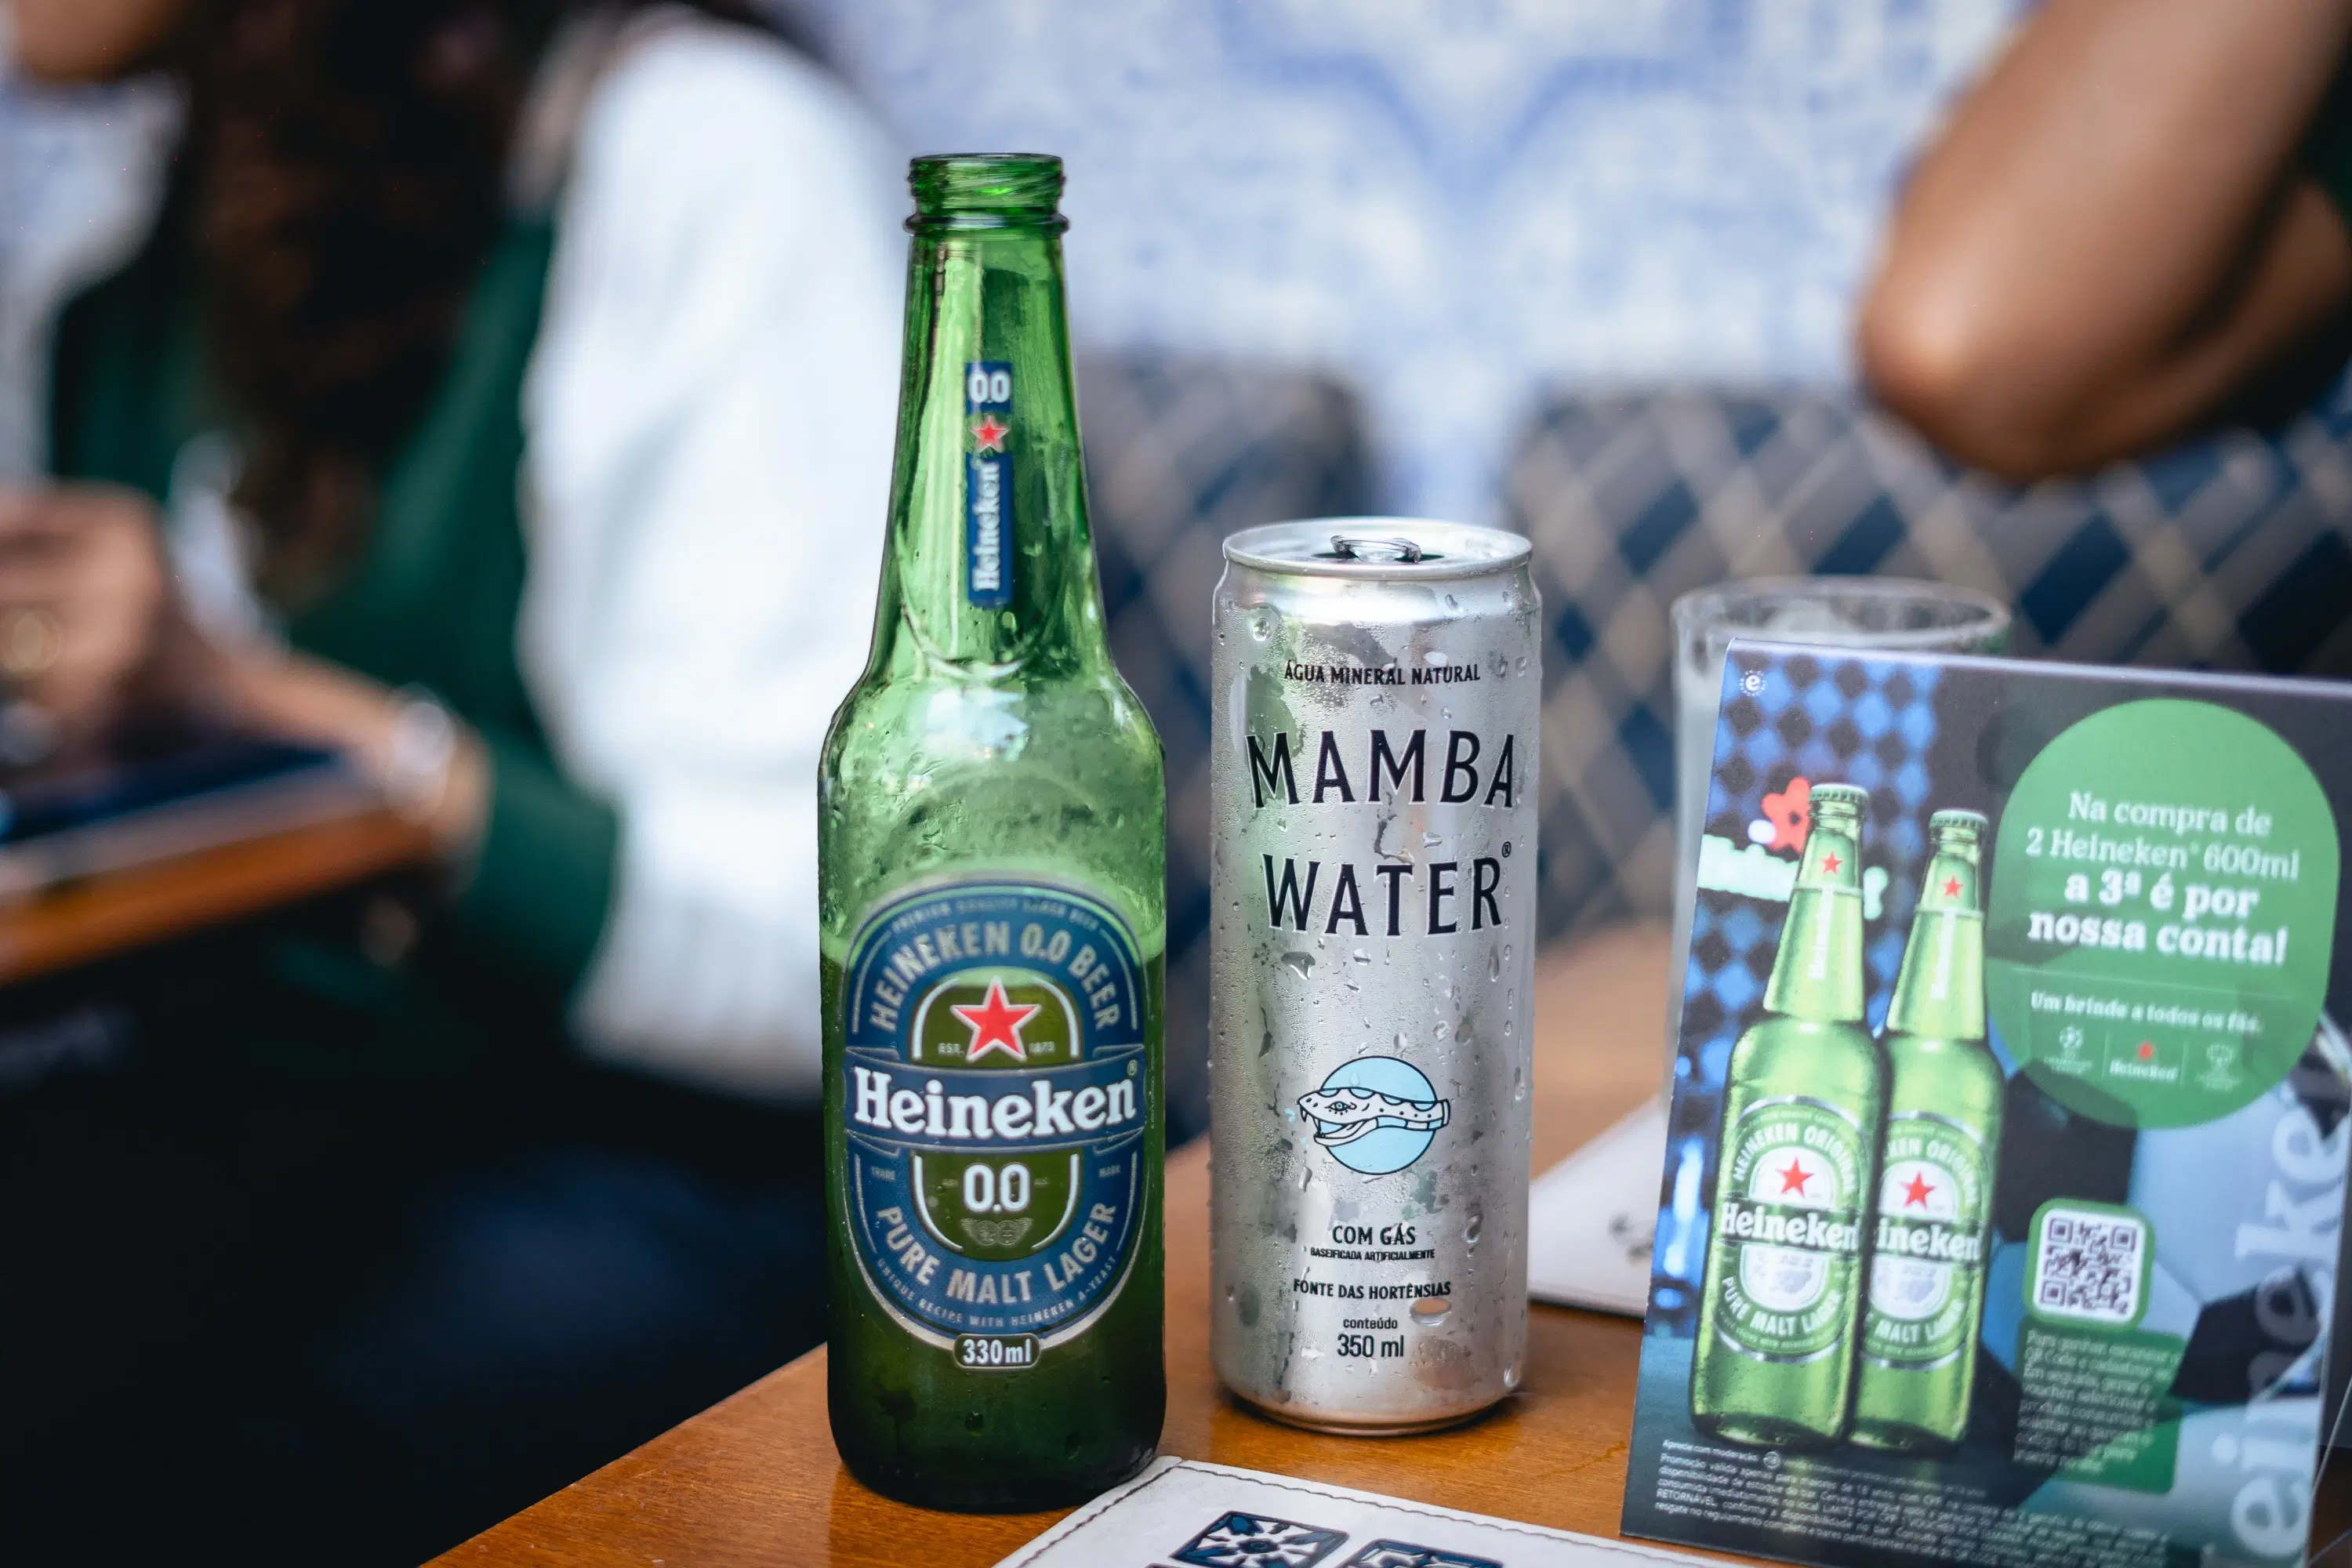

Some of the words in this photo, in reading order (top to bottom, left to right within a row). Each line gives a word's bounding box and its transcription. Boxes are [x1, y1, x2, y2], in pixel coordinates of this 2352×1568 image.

[972, 461, 1000, 591] Heineken
[1283, 659, 1325, 684] ÁGUA
[1330, 666, 1406, 686] MINERAL
[1411, 664, 1481, 685] NATURAL
[1245, 729, 1515, 808] MAMBA
[2068, 790, 2106, 822] Na
[2113, 803, 2227, 837] compra
[2234, 806, 2272, 837] de
[2026, 828, 2044, 857] 2
[2203, 844, 2299, 881] 600ml
[2064, 873, 2089, 903] a
[2099, 868, 2142, 906] 3ª
[2151, 872, 2174, 909] é
[2183, 883, 2259, 920] por
[2027, 912, 2147, 951] nossa
[2156, 924, 2288, 966] conta!
[869, 922, 1010, 1033] HEINEKEN
[1021, 923, 1072, 964] 0.0
[1069, 943, 1120, 1029] BEER
[2031, 993, 2062, 1011] Um
[2064, 996, 2129, 1017] brinde
[2132, 1006, 2143, 1022] a
[2147, 1004, 2200, 1025] todos
[2202, 1012, 2224, 1029] os
[964, 1163, 1030, 1213] 0.0
[1332, 1225, 1373, 1246] COM
[1380, 1223, 1417, 1246] GÁS
[1719, 1202, 1860, 1251] Heineken
[877, 1206, 940, 1286] PURE
[946, 1268, 1032, 1305] MALT
[1044, 1203, 1116, 1292] LAGER
[1293, 1278, 1334, 1297] FONTE
[1338, 1281, 1365, 1299] DAS
[1369, 1280, 1451, 1300] HORTÊNSIAS
[969, 1315, 1004, 1327] WITH
[1342, 1316, 1398, 1330] conteúdo
[1336, 1334, 1374, 1358] 350
[1381, 1334, 1404, 1357] ml
